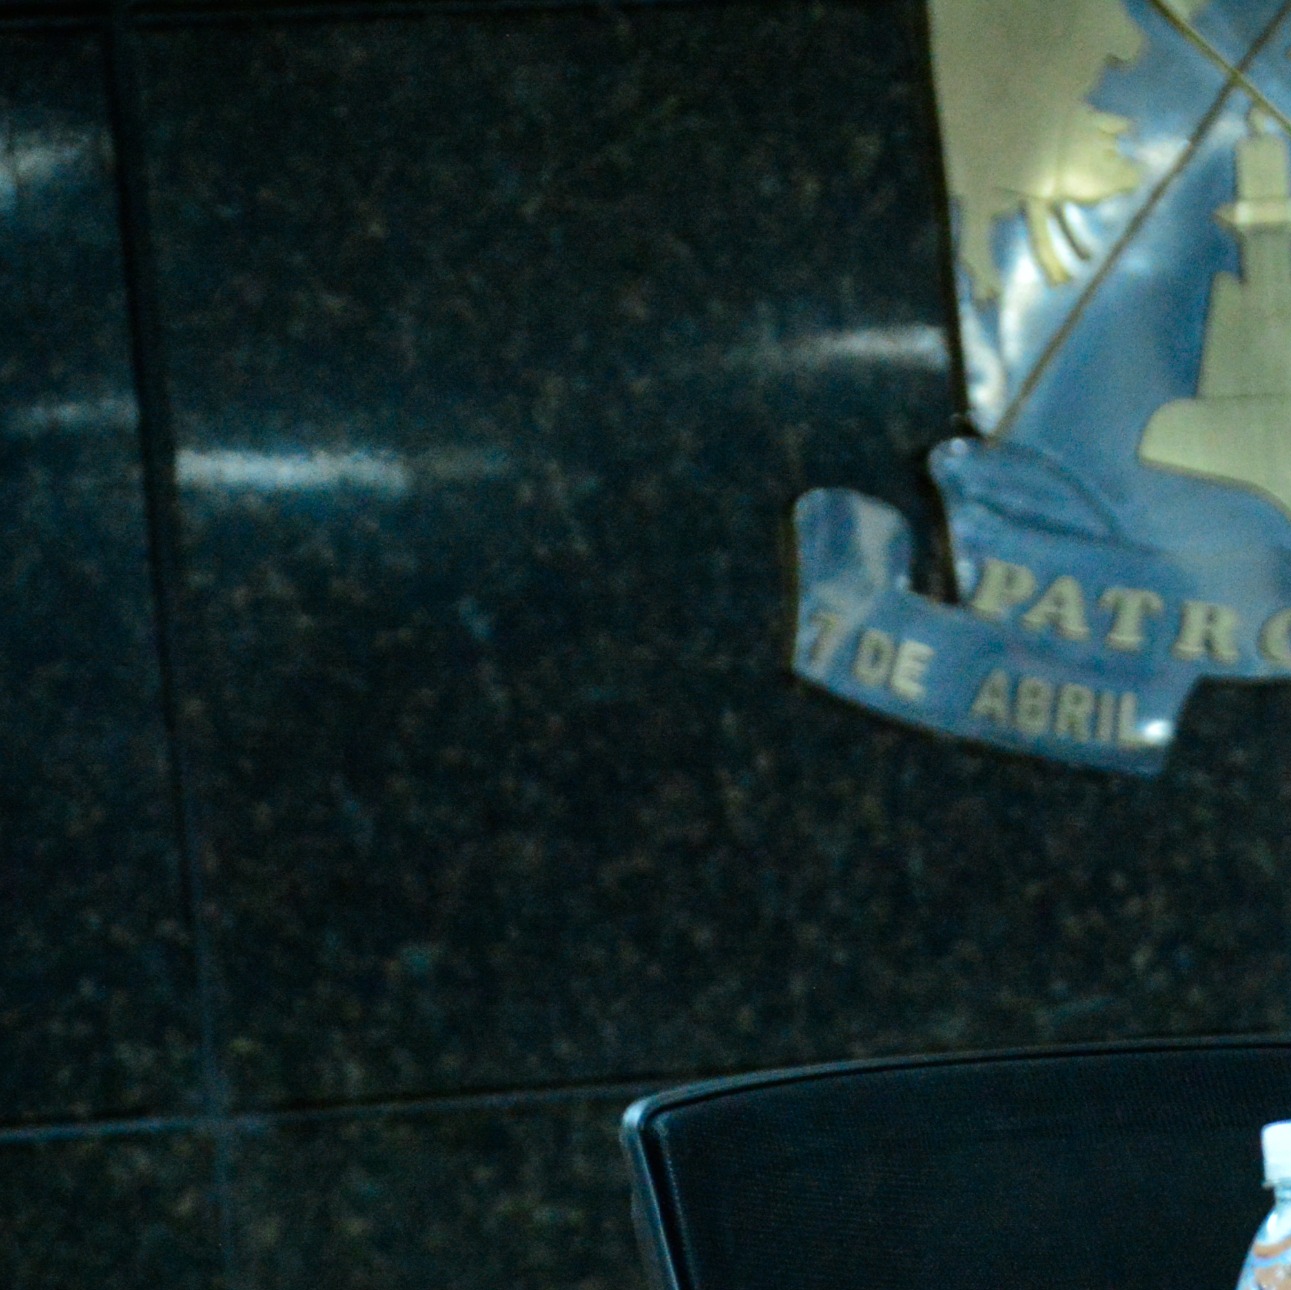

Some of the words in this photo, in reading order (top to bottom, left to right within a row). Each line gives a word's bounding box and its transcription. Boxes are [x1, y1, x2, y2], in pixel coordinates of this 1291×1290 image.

[807, 609, 842, 672] 7
[852, 627, 935, 699] DE
[969, 667, 1170, 748] ABRIL
